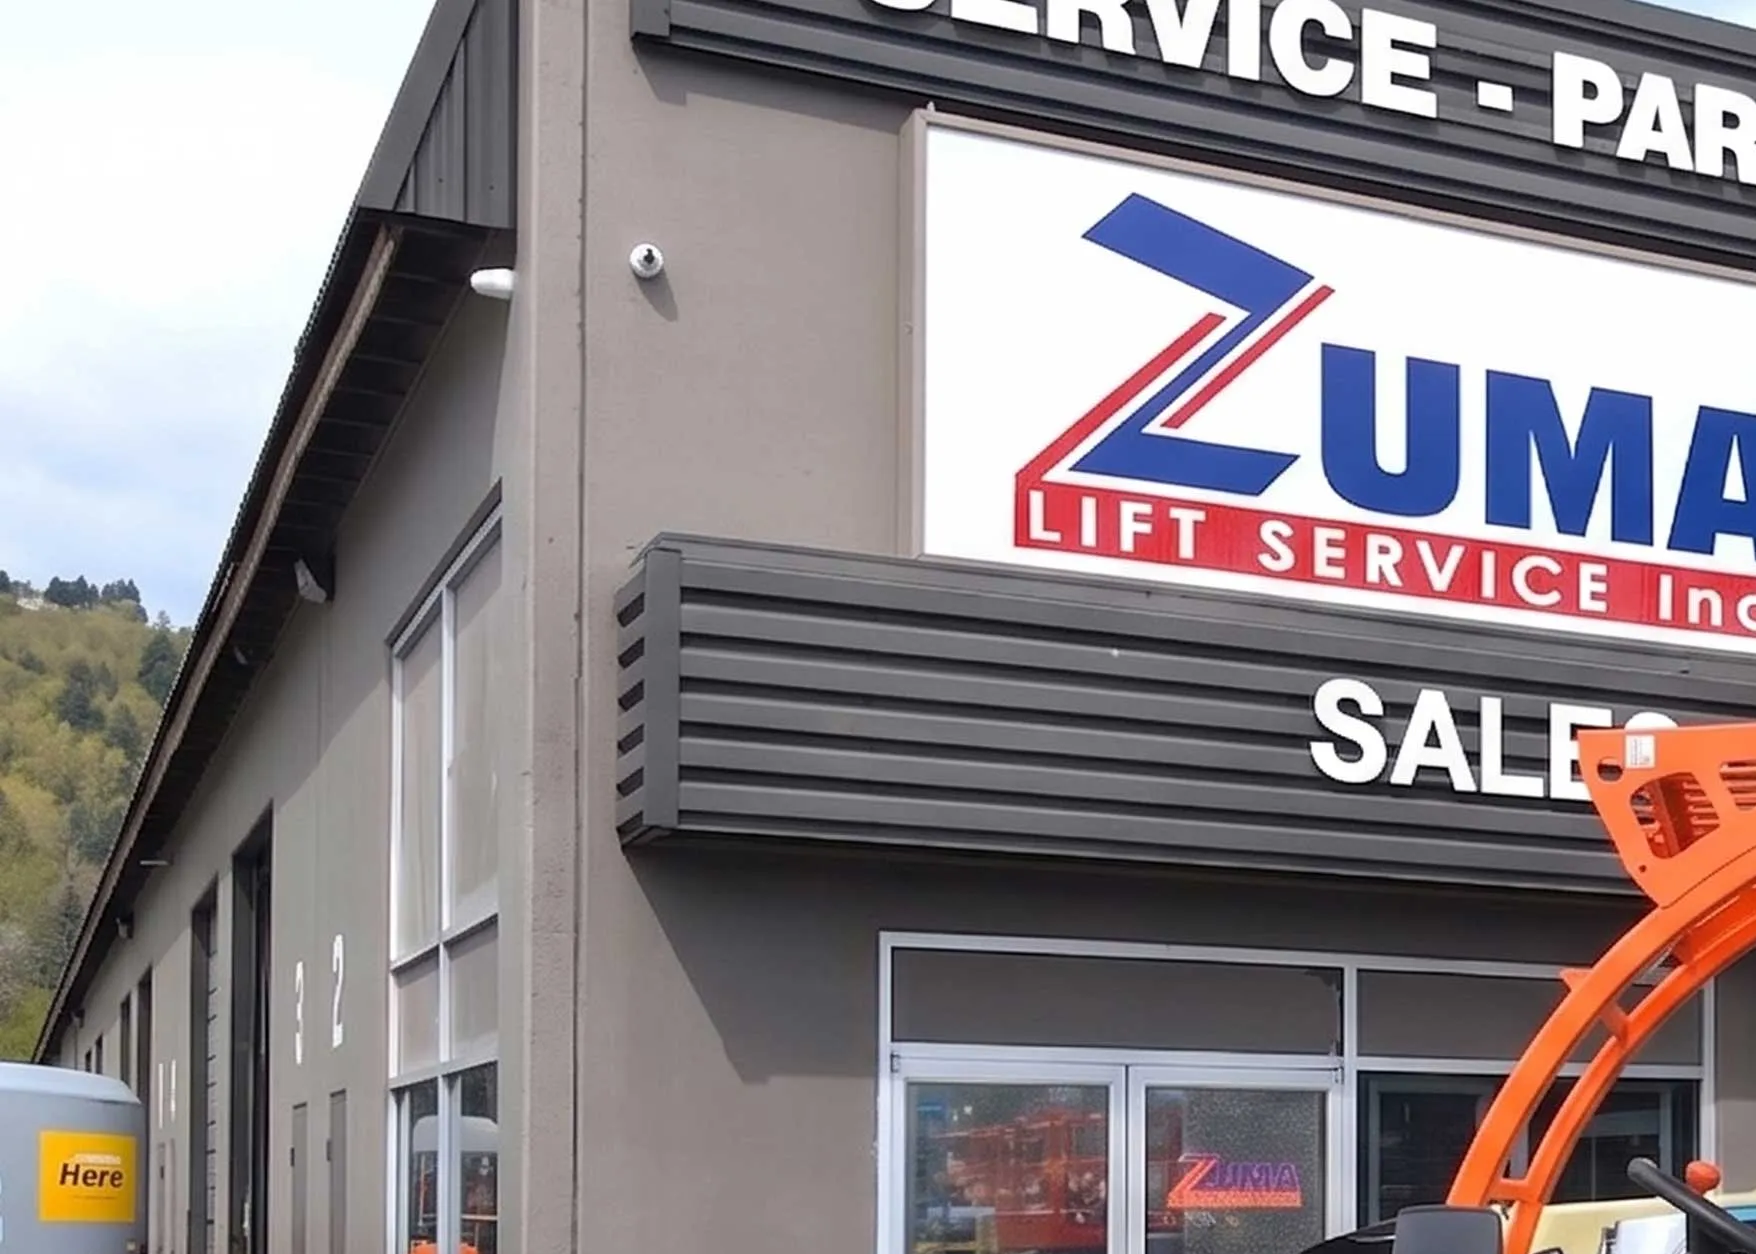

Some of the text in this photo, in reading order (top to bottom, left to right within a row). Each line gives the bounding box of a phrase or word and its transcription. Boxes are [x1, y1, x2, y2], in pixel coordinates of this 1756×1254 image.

[871, 0, 1437, 118] VICE
[1029, 490, 1206, 560] LIFT
[1257, 518, 1608, 613] SERVICE
[1310, 678, 1677, 801] SALE
[332, 934, 344, 1048] 2
[59, 1163, 124, 1188] Here
